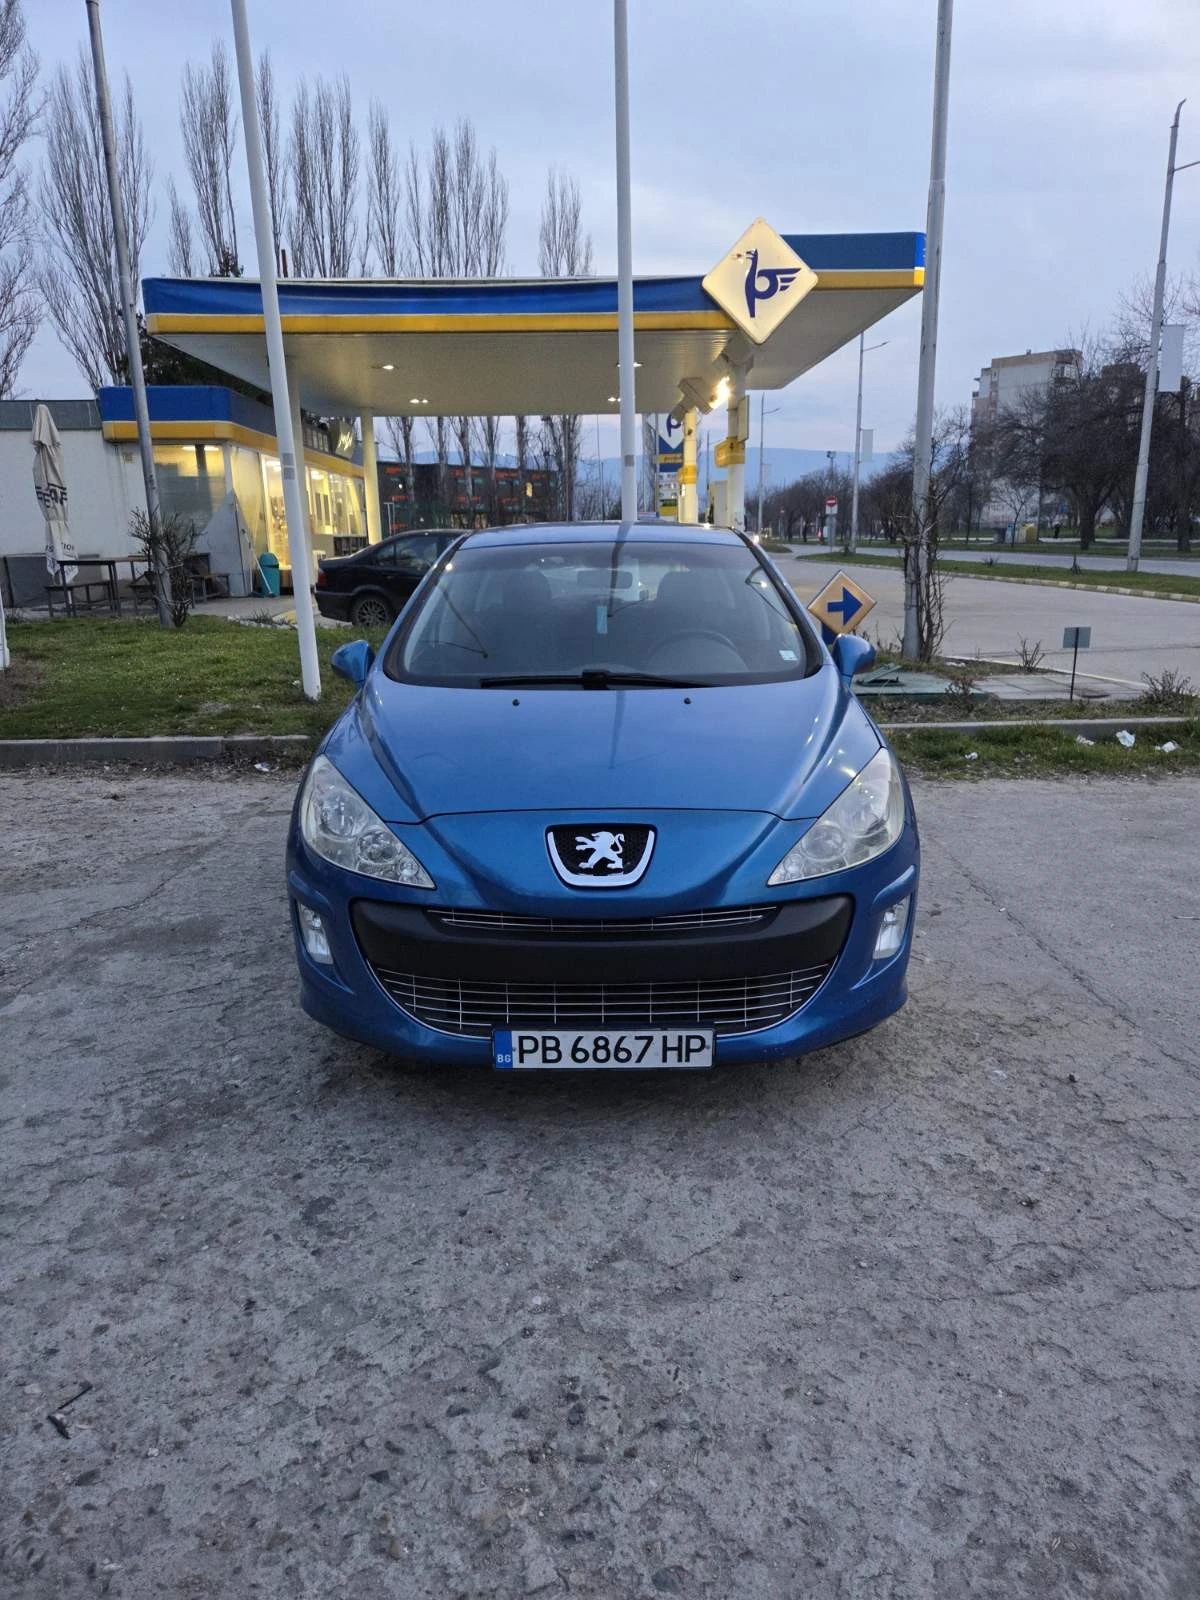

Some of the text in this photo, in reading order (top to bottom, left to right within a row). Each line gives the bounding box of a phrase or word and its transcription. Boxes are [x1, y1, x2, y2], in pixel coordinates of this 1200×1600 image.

[497, 1054, 511, 1063] BG
[518, 1035, 706, 1064] PB 6867 HP
